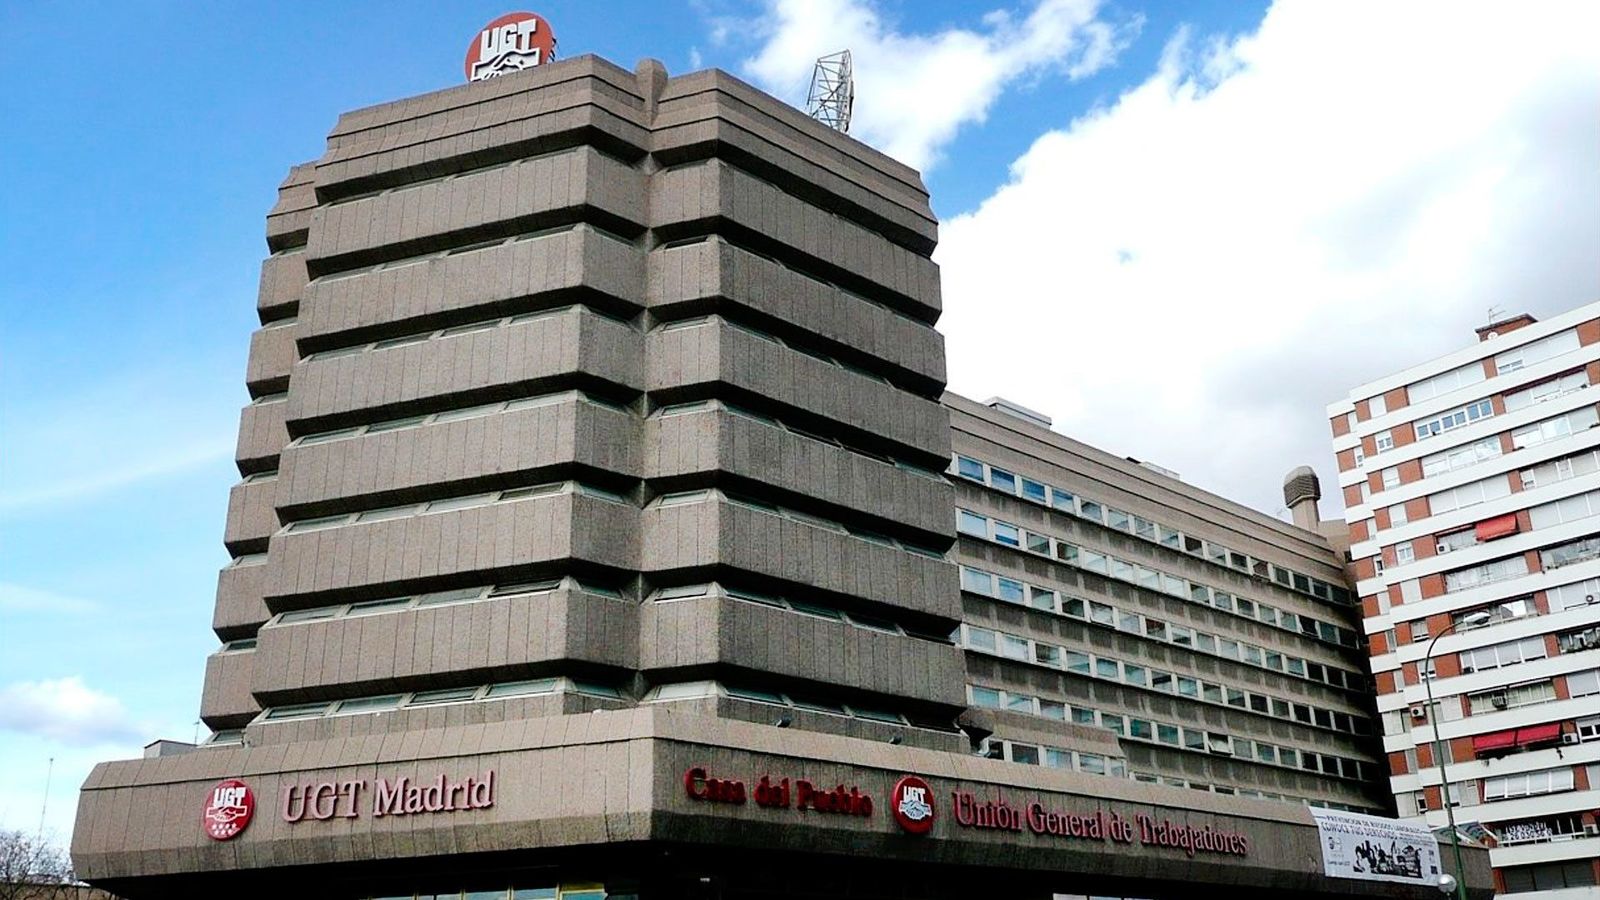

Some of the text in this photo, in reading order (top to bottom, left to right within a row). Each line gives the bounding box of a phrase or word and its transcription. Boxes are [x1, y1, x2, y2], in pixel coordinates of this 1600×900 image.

[481, 19, 536, 61] UGT
[214, 787, 246, 808] UGT
[283, 770, 495, 822] UGT Madrid
[685, 768, 872, 816] Casa del Pueblo
[903, 785, 926, 805] UGT
[1026, 801, 1105, 841] General
[1108, 807, 1133, 843] de
[1137, 814, 1248, 858] Trabajadores
